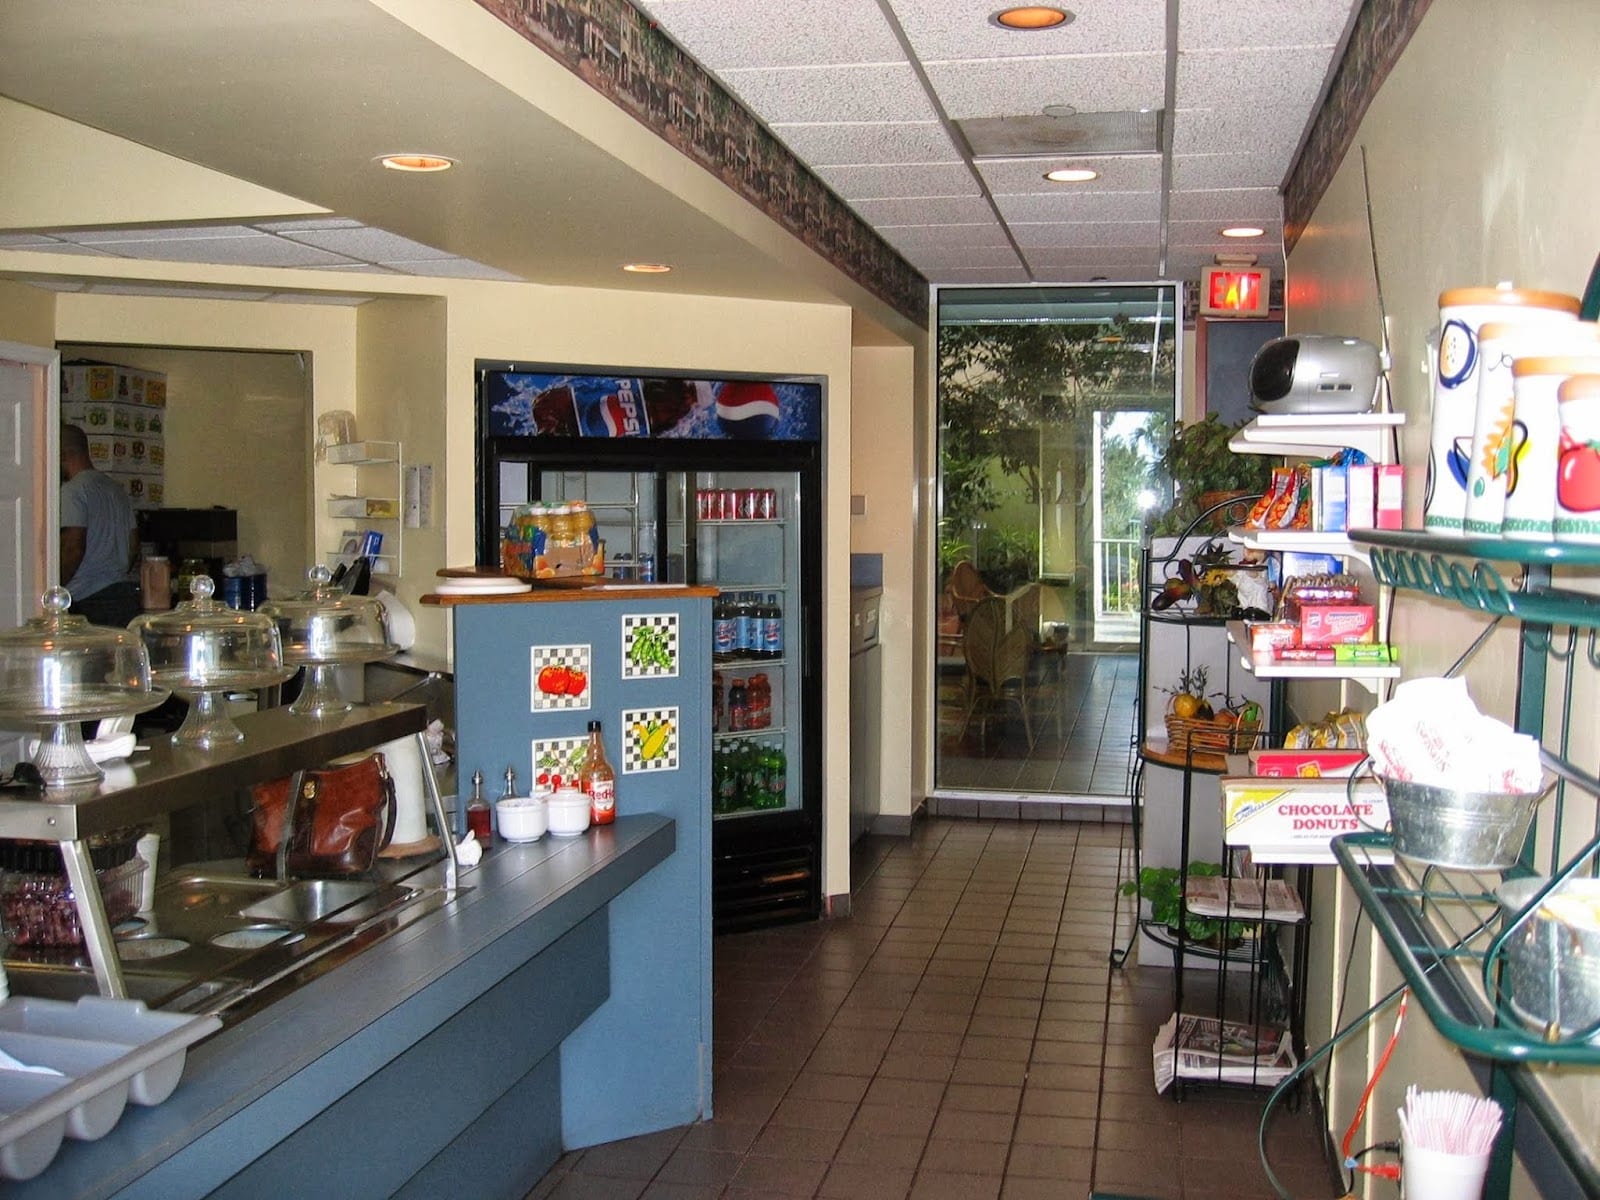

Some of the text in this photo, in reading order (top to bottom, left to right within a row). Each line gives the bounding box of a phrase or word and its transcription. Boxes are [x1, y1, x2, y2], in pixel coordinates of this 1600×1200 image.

[1210, 272, 1261, 310] EXIT
[615, 379, 641, 435] PEPSI
[1278, 804, 1374, 816] CHOCOLATE
[1293, 818, 1359, 830] DONUTS
